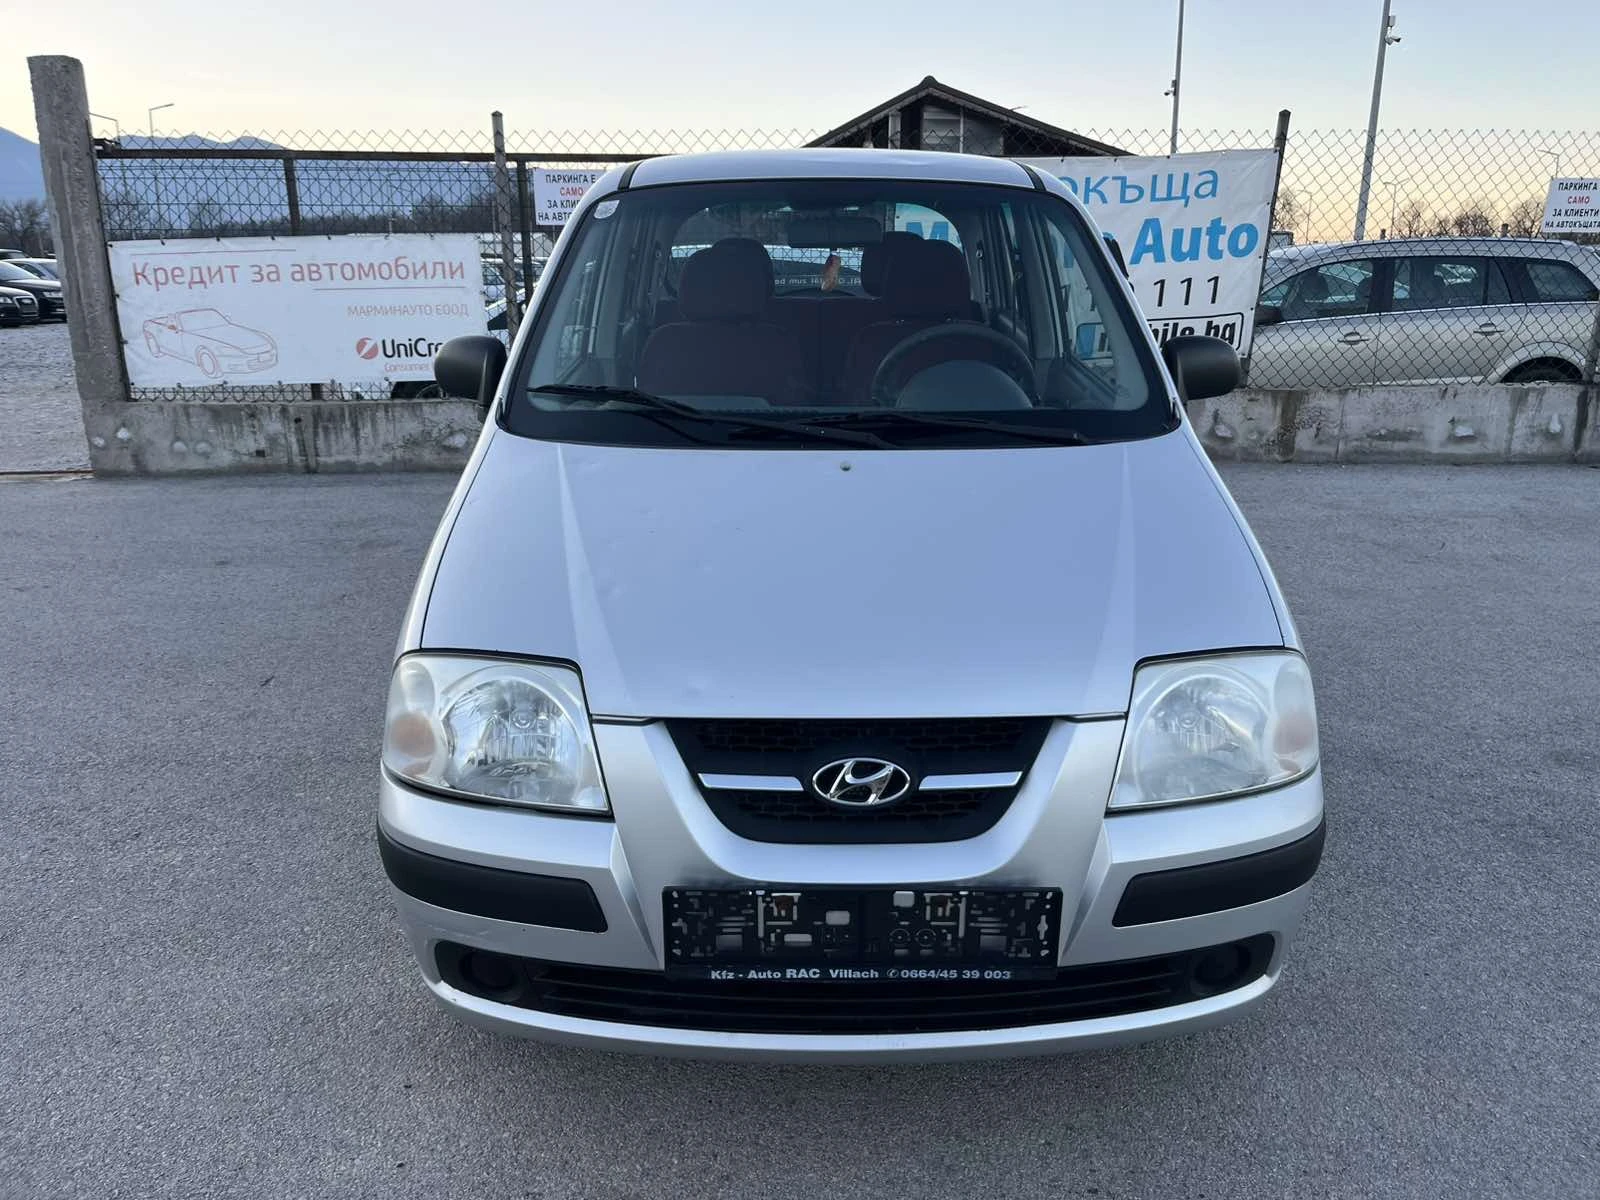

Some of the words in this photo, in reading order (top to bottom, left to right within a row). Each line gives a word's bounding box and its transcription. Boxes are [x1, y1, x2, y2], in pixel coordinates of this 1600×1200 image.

[546, 175, 588, 184] ПАРКИНГА
[1558, 182, 1597, 191] ПАРКИНГА
[560, 187, 584, 196] САМО
[547, 200, 558, 208] ЗА
[1567, 196, 1590, 204] САМО
[537, 212, 549, 221] НА
[1552, 209, 1562, 217] ЗА
[1564, 209, 1600, 217] КЛИЕНТИ
[1129, 217, 1259, 265] Auto
[133, 262, 241, 291] Кредит
[251, 262, 282, 283] за
[290, 256, 466, 283] автомобили
[347, 304, 433, 318] МАРМИНАУТО
[435, 304, 470, 317] ЕООД
[711, 969, 734, 980] Kfz
[747, 969, 781, 979] Auto
[786, 968, 820, 979] RAC
[829, 968, 879, 979] Villach
[901, 969, 957, 979] 0664/45
[962, 969, 980, 979] 39
[985, 969, 1011, 979] 003
